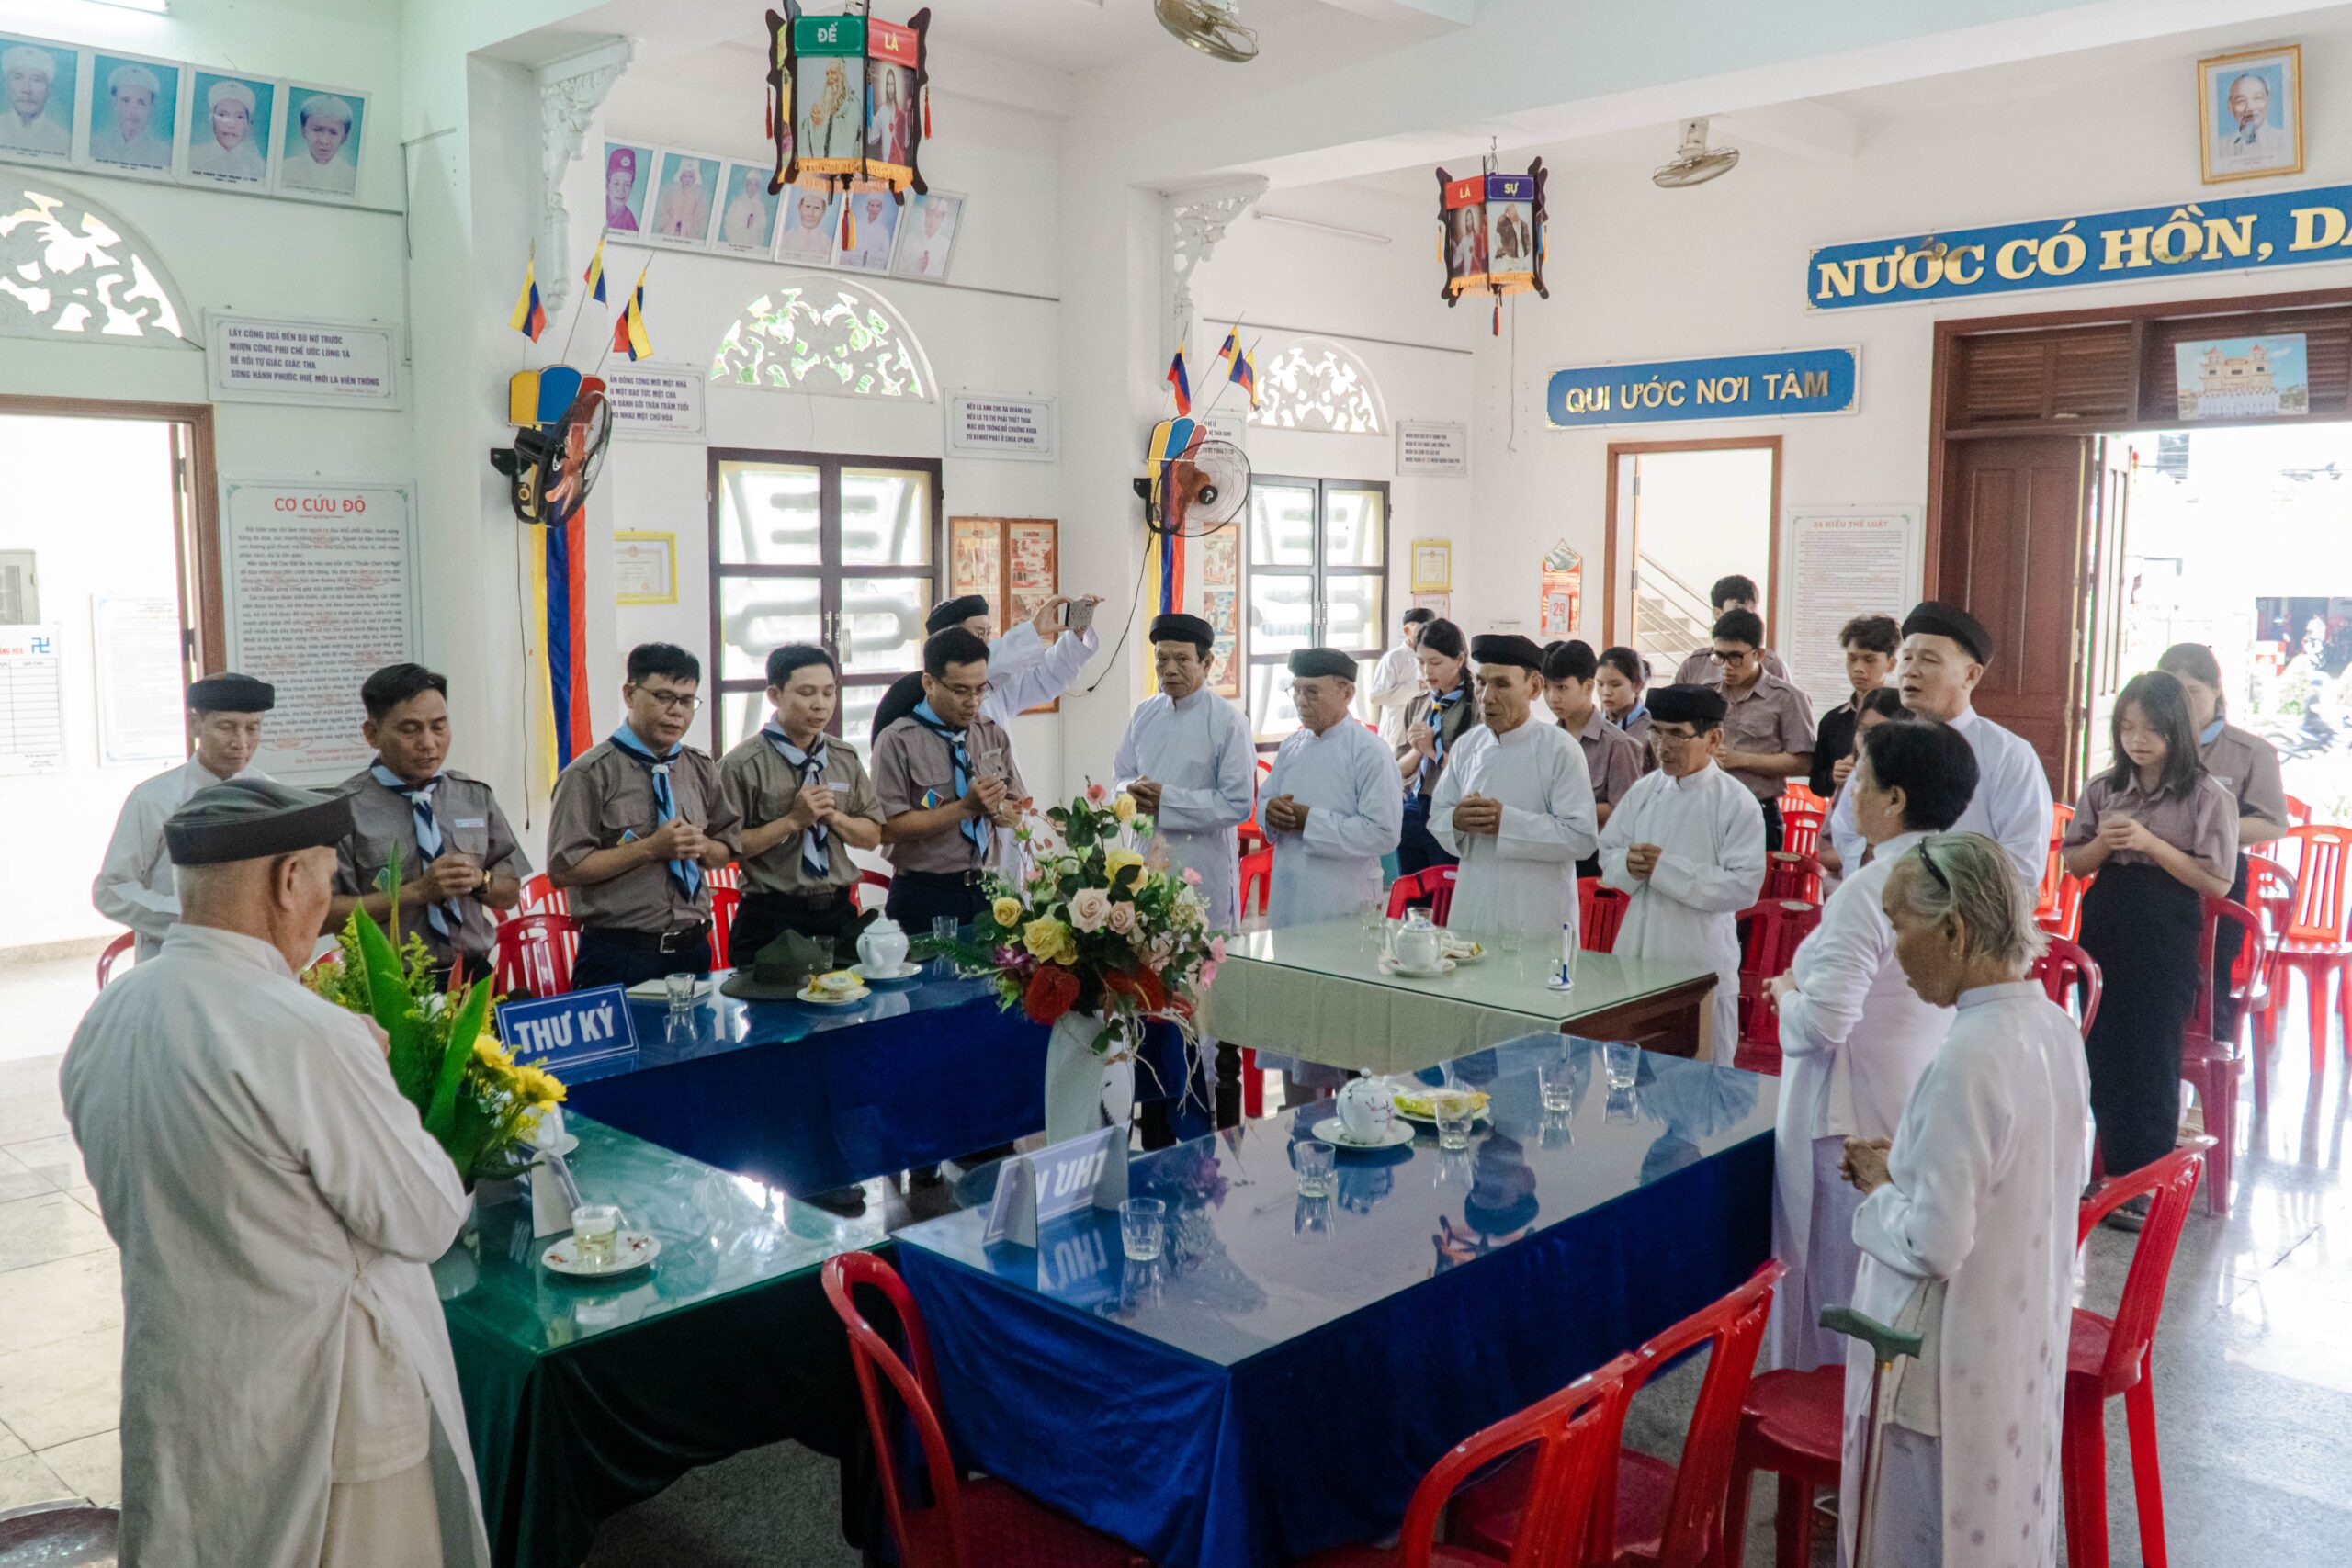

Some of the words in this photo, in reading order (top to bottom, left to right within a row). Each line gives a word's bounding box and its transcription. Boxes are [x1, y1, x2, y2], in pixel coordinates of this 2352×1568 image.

[817, 22, 838, 43] ĐẾ
[884, 32, 899, 52] LÀ
[1459, 184, 1471, 199] LÀ
[1504, 181, 1519, 197] SỰ
[1816, 236, 1985, 299] NƯỚC
[1996, 220, 2086, 280] CÓ
[2099, 204, 2274, 271] HỒN,
[1566, 386, 1611, 414] QUI
[1620, 375, 1686, 409] ƯỚC
[1696, 376, 1749, 405] NƠI
[1763, 368, 1829, 400] TÂM
[274, 497, 297, 512] CƠ
[302, 494, 336, 512] CỨU
[342, 495, 366, 516] ĐỘ
[513, 1010, 573, 1054] THƯ
[578, 999, 614, 1043] KÝ
